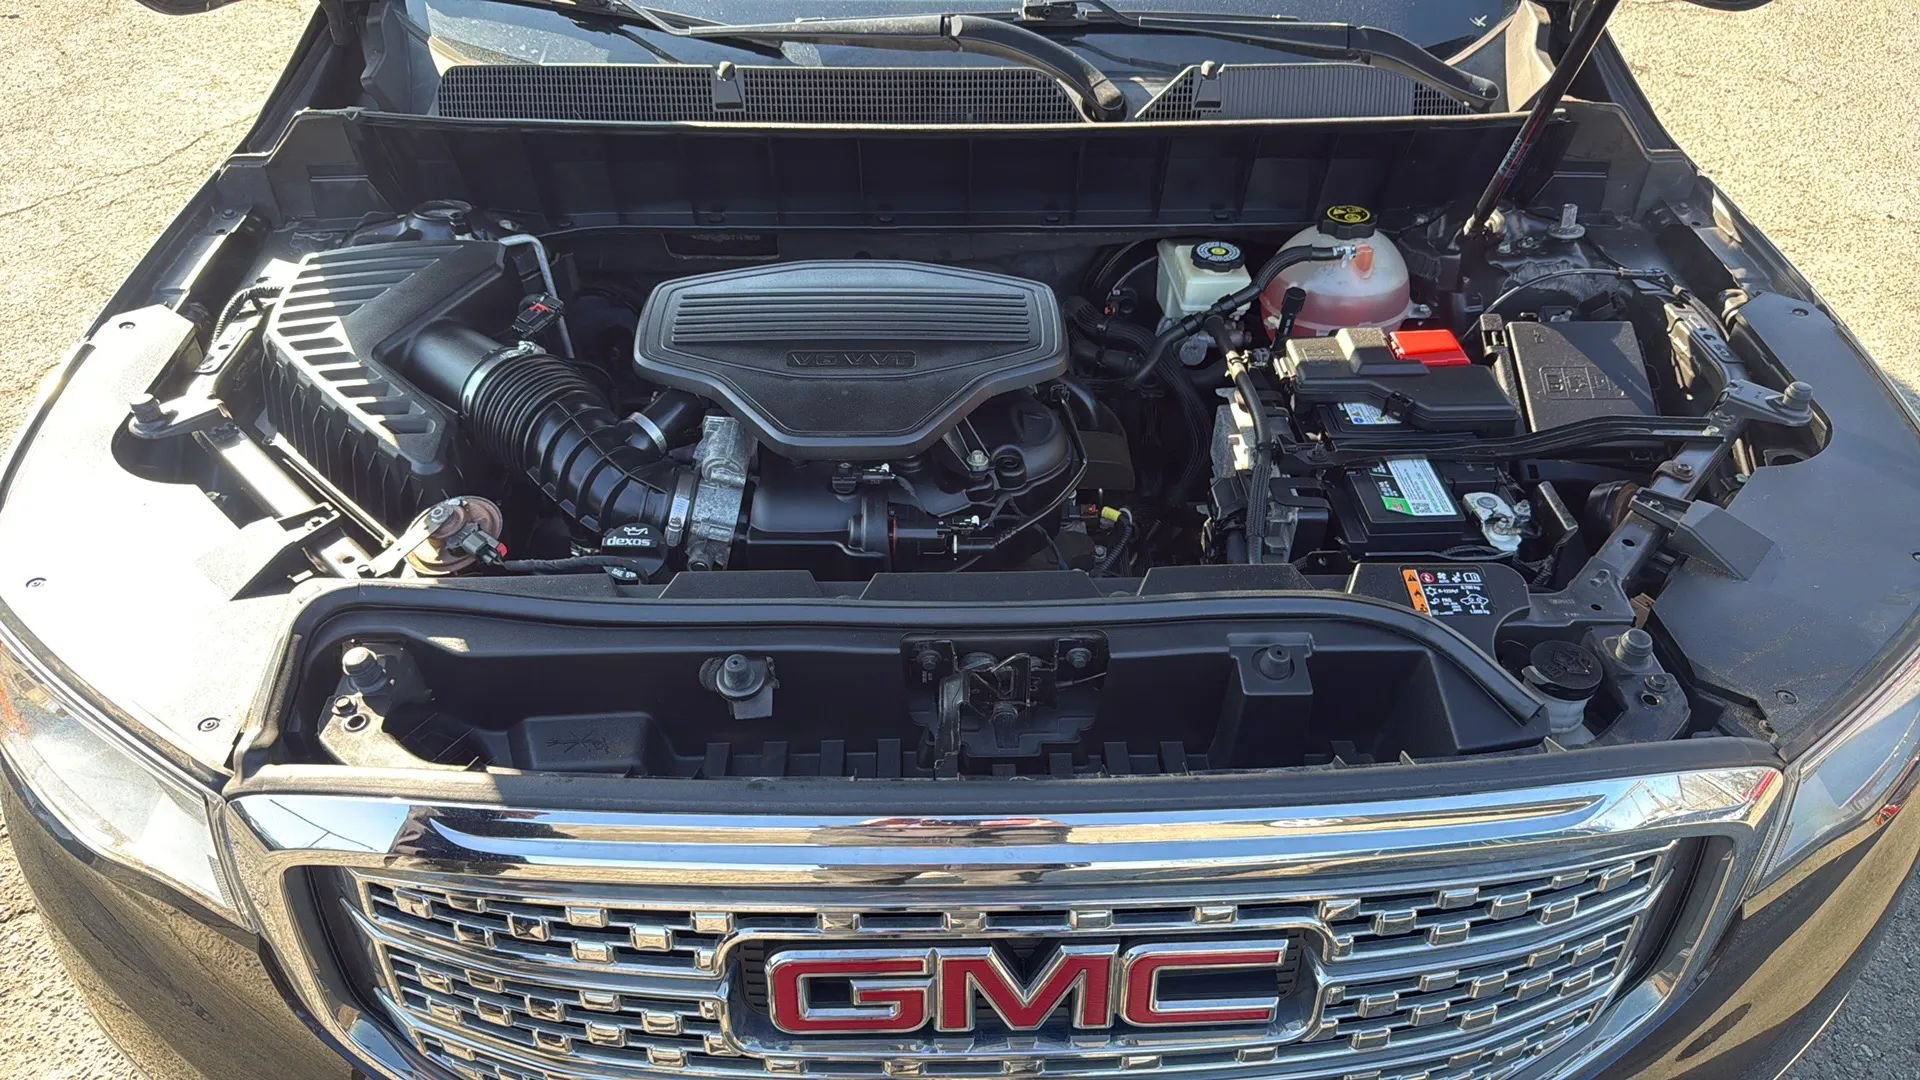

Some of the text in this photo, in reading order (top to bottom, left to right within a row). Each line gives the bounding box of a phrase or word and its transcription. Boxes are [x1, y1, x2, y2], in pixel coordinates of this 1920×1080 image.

[791, 352, 914, 366] V6 VVT
[607, 536, 651, 546] dexos
[767, 938, 1289, 1034] GMC
